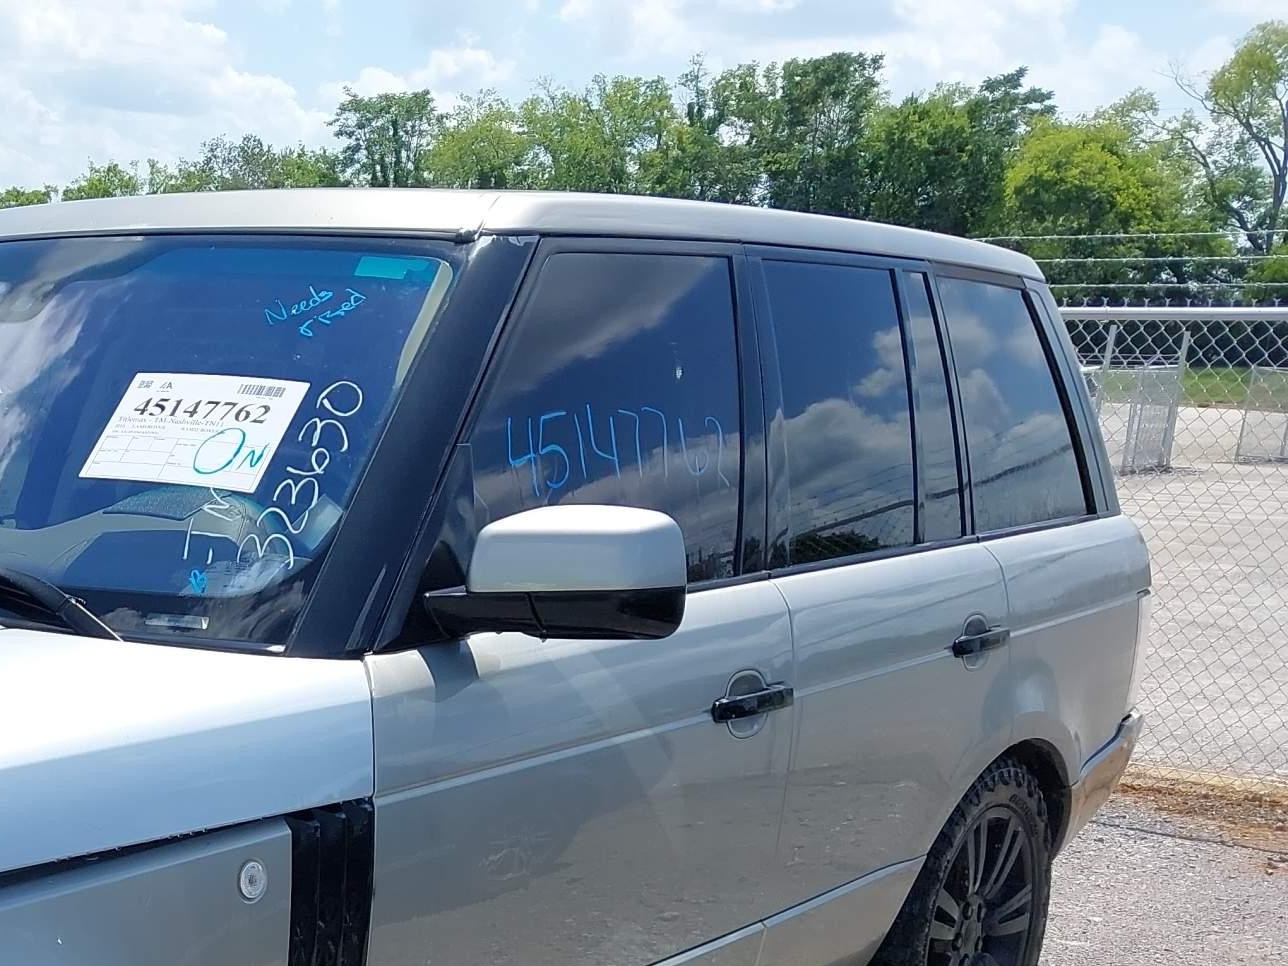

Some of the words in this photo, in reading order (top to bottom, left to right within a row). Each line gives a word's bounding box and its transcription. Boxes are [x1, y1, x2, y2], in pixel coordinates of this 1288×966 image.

[264, 285, 333, 325] Needs
[133, 397, 271, 424] 45147762
[193, 428, 270, 474] ON
[507, 404, 730, 496] 45147762
[237, 380, 362, 569] 323630
